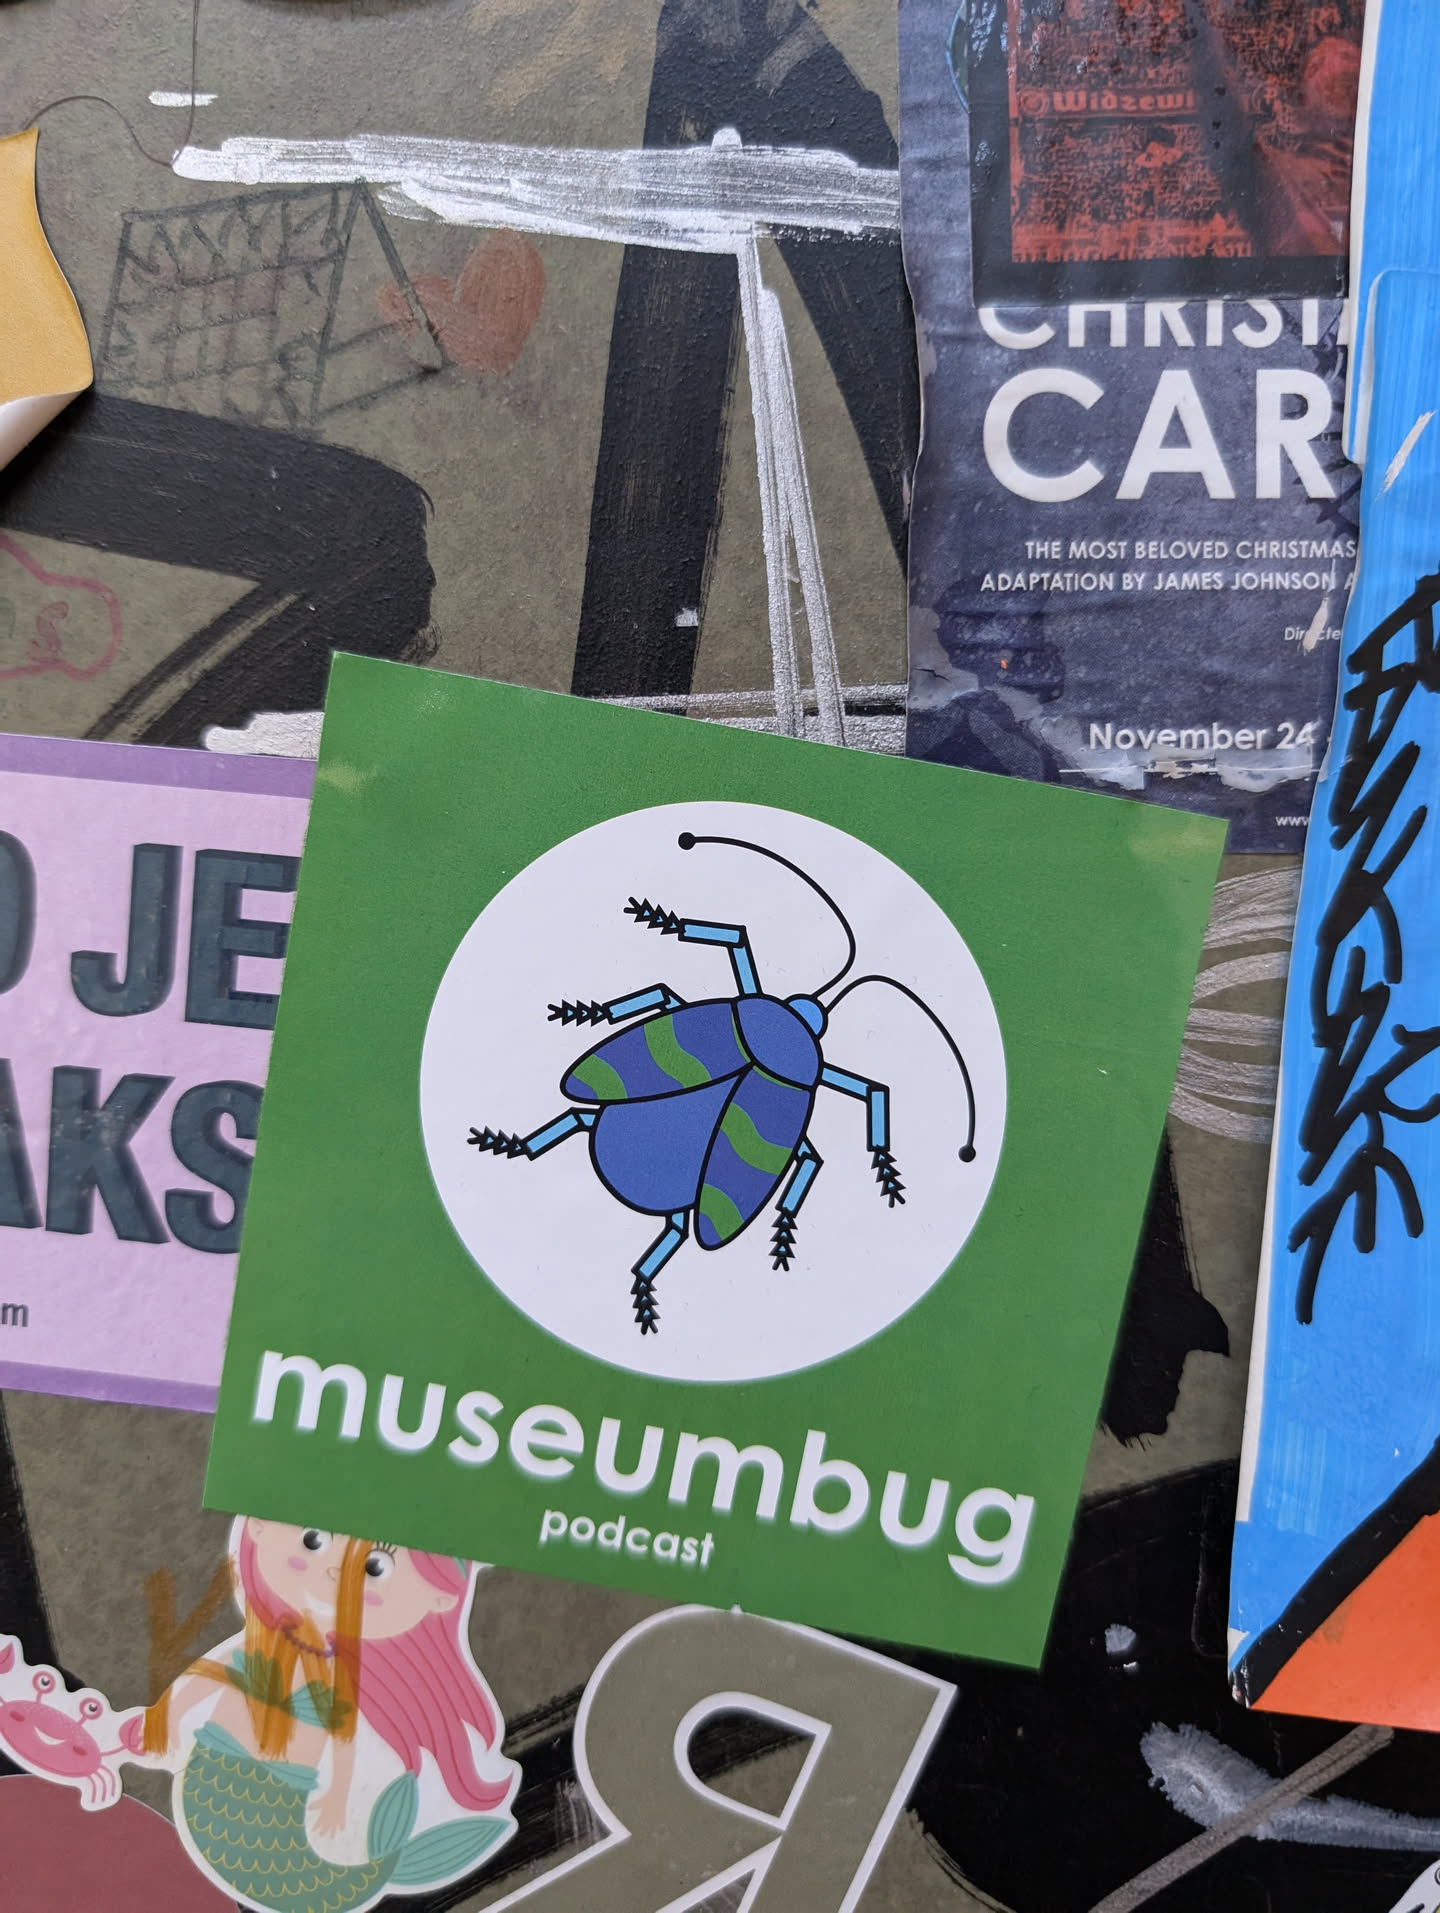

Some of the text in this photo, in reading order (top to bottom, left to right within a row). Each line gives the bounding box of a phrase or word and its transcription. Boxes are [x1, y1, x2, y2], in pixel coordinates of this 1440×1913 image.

[977, 298, 1348, 350] CHRIST
[982, 368, 1337, 503] CAR
[1025, 539, 1357, 560] THE MOST BELOVED CHRISTMAS
[980, 572, 1114, 592] ADAPTATION
[1121, 572, 1147, 591] BY
[1153, 572, 1224, 591] JAMES
[1230, 571, 1336, 591] JOHNSON
[1089, 721, 1317, 750] November 24
[252, 1349, 1036, 1586] museumbug
[538, 1508, 715, 1569] podcast
